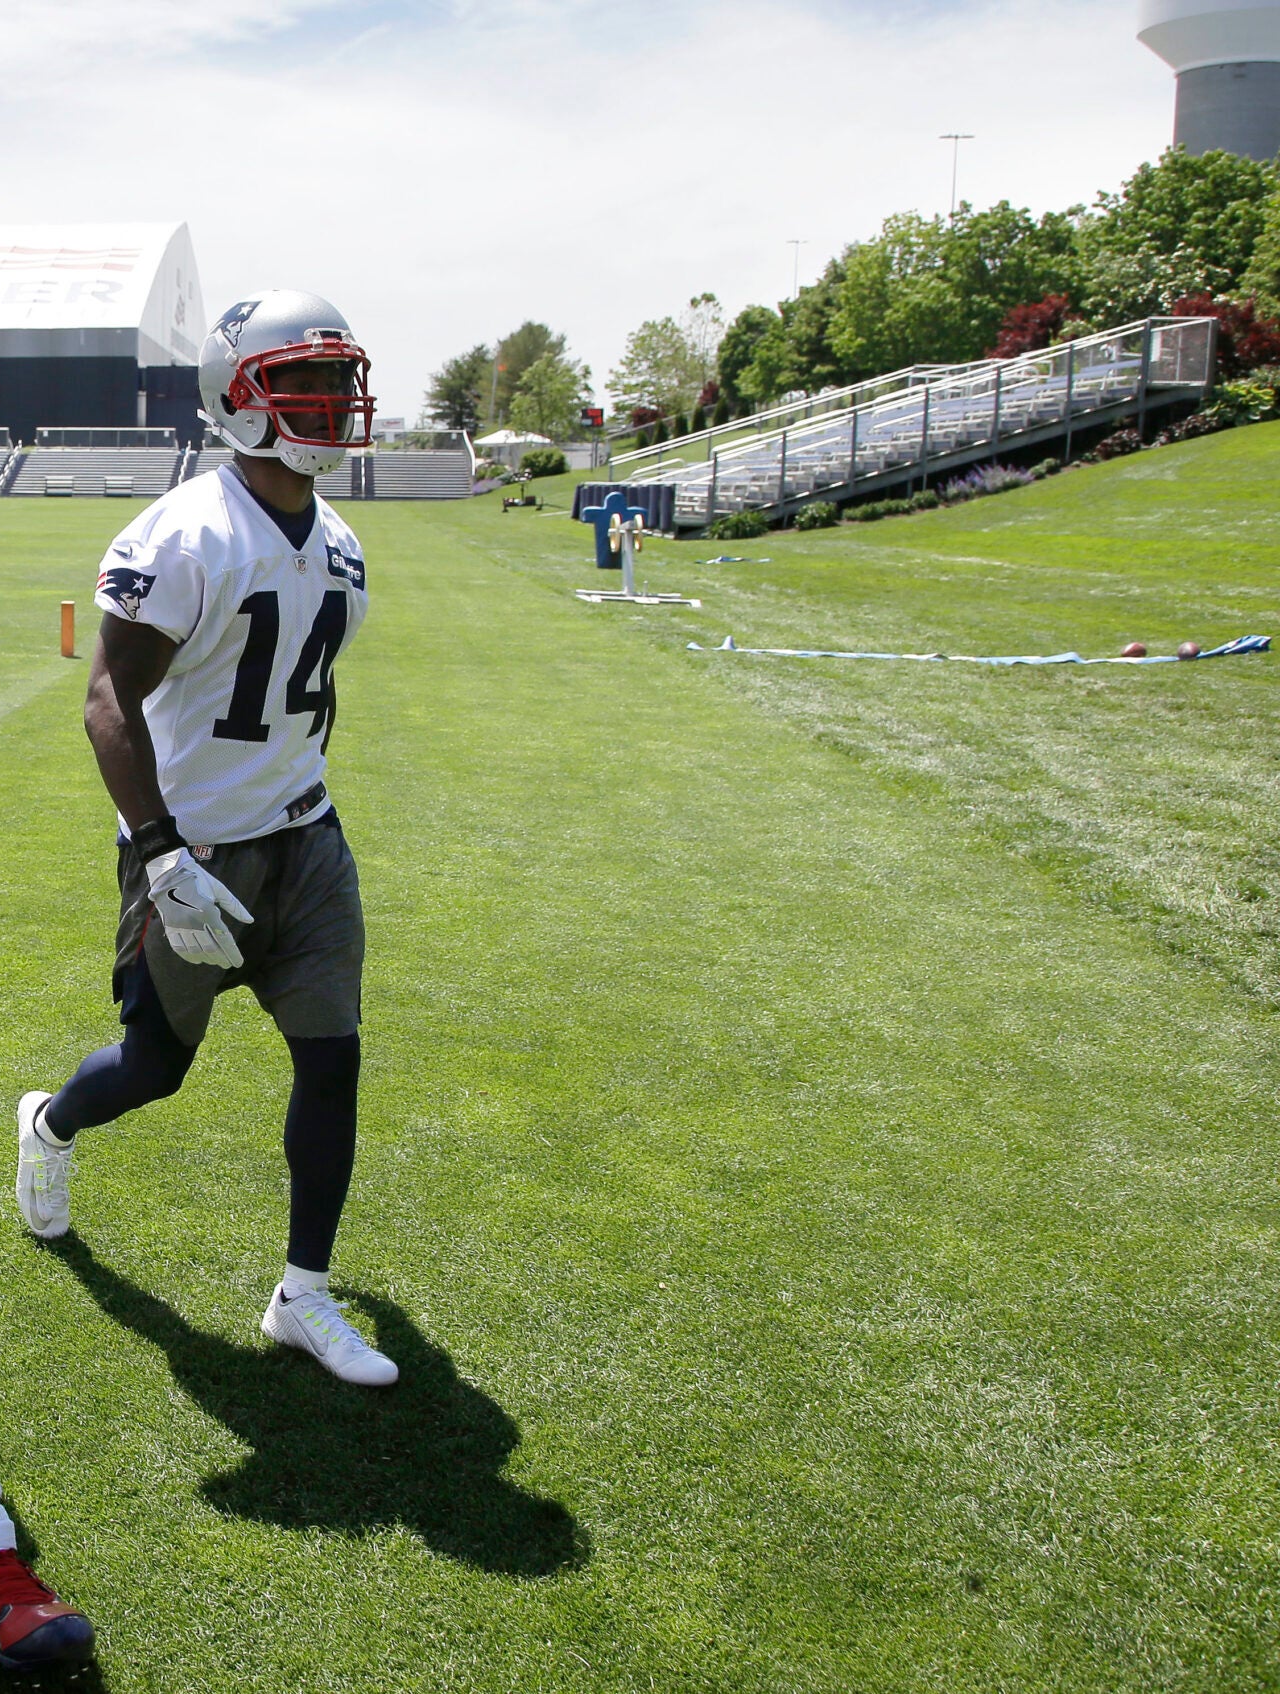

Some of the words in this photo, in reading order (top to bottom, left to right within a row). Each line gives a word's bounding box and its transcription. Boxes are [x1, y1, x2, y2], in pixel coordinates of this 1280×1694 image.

[331, 554, 361, 580] Giltte
[212, 590, 347, 742] 14
[194, 845, 209, 857] NFL
